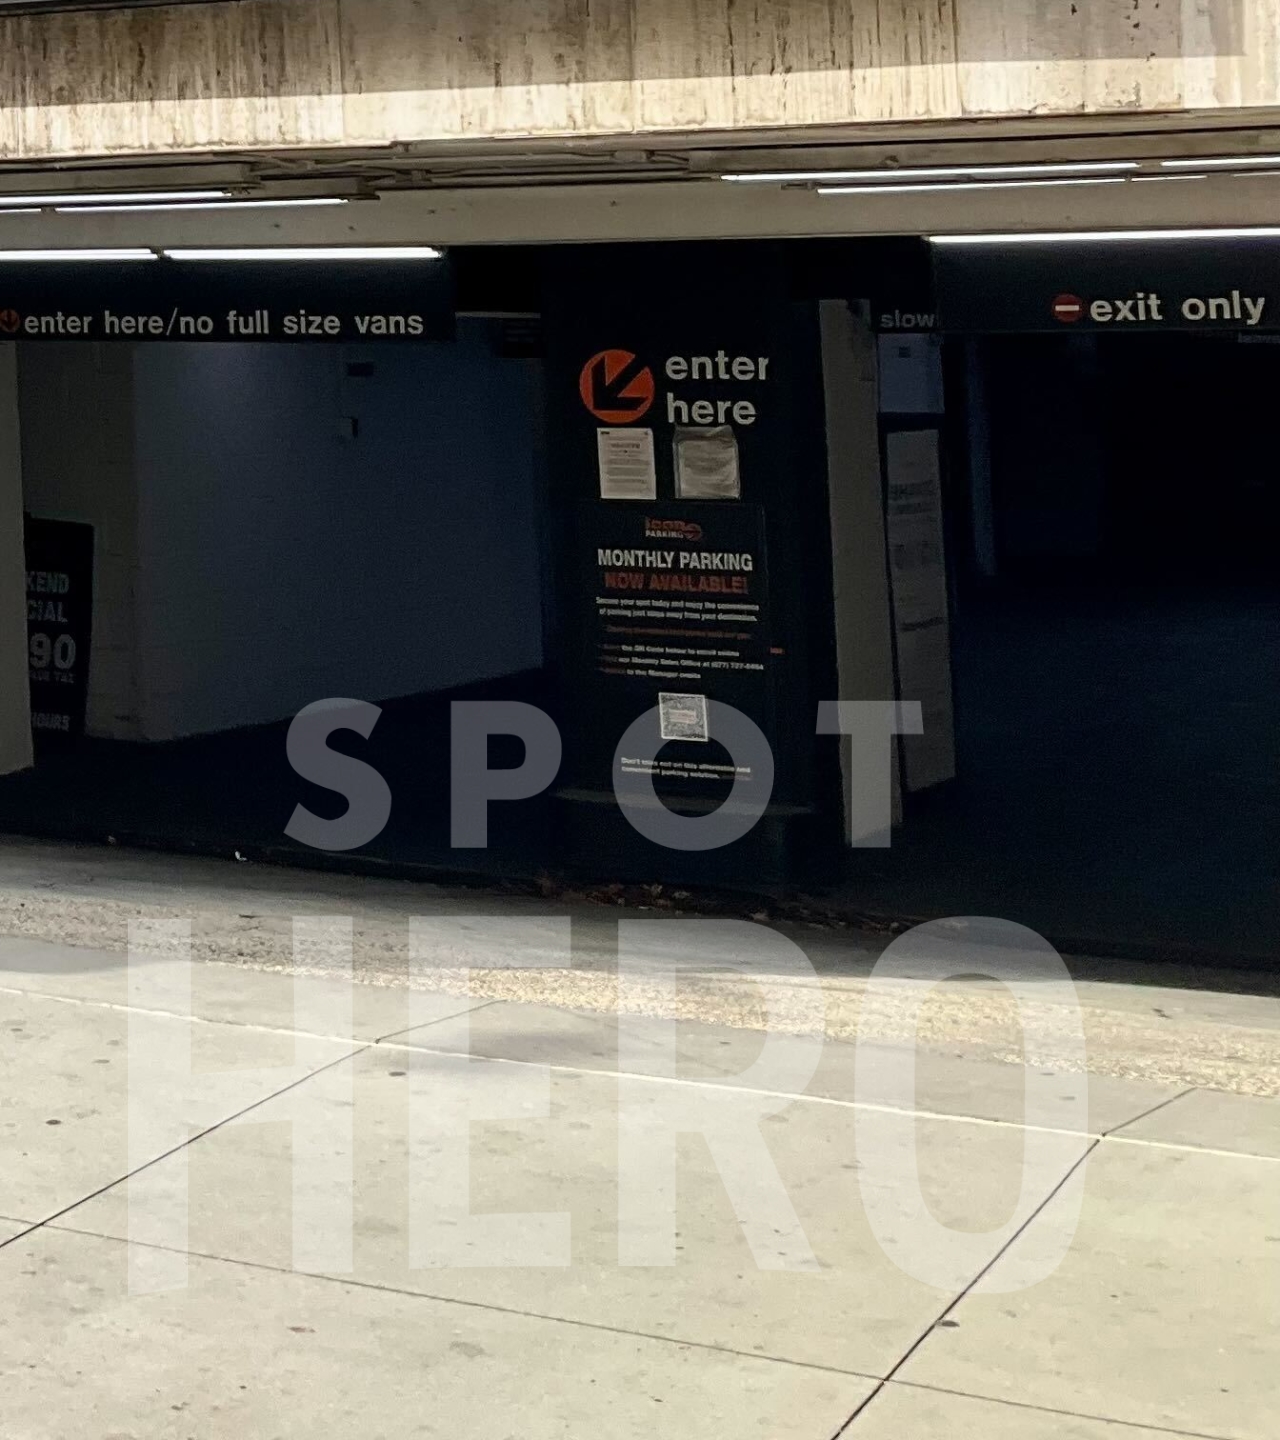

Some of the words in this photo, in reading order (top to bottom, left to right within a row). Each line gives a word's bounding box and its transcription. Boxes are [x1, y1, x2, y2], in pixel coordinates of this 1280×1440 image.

[24, 311, 92, 334] enter
[104, 306, 213, 336] here/no
[227, 309, 270, 335] full
[282, 309, 341, 335] size
[354, 313, 424, 336] vans
[880, 309, 935, 329] slow
[1089, 293, 1163, 322] exit
[1181, 290, 1266, 325] only
[665, 350, 770, 381] enter
[666, 392, 756, 425] here
[597, 548, 674, 568] MONTHLY
[679, 551, 754, 571] PARKING
[604, 571, 645, 590] NOW
[648, 572, 749, 595] AVAILABLE!
